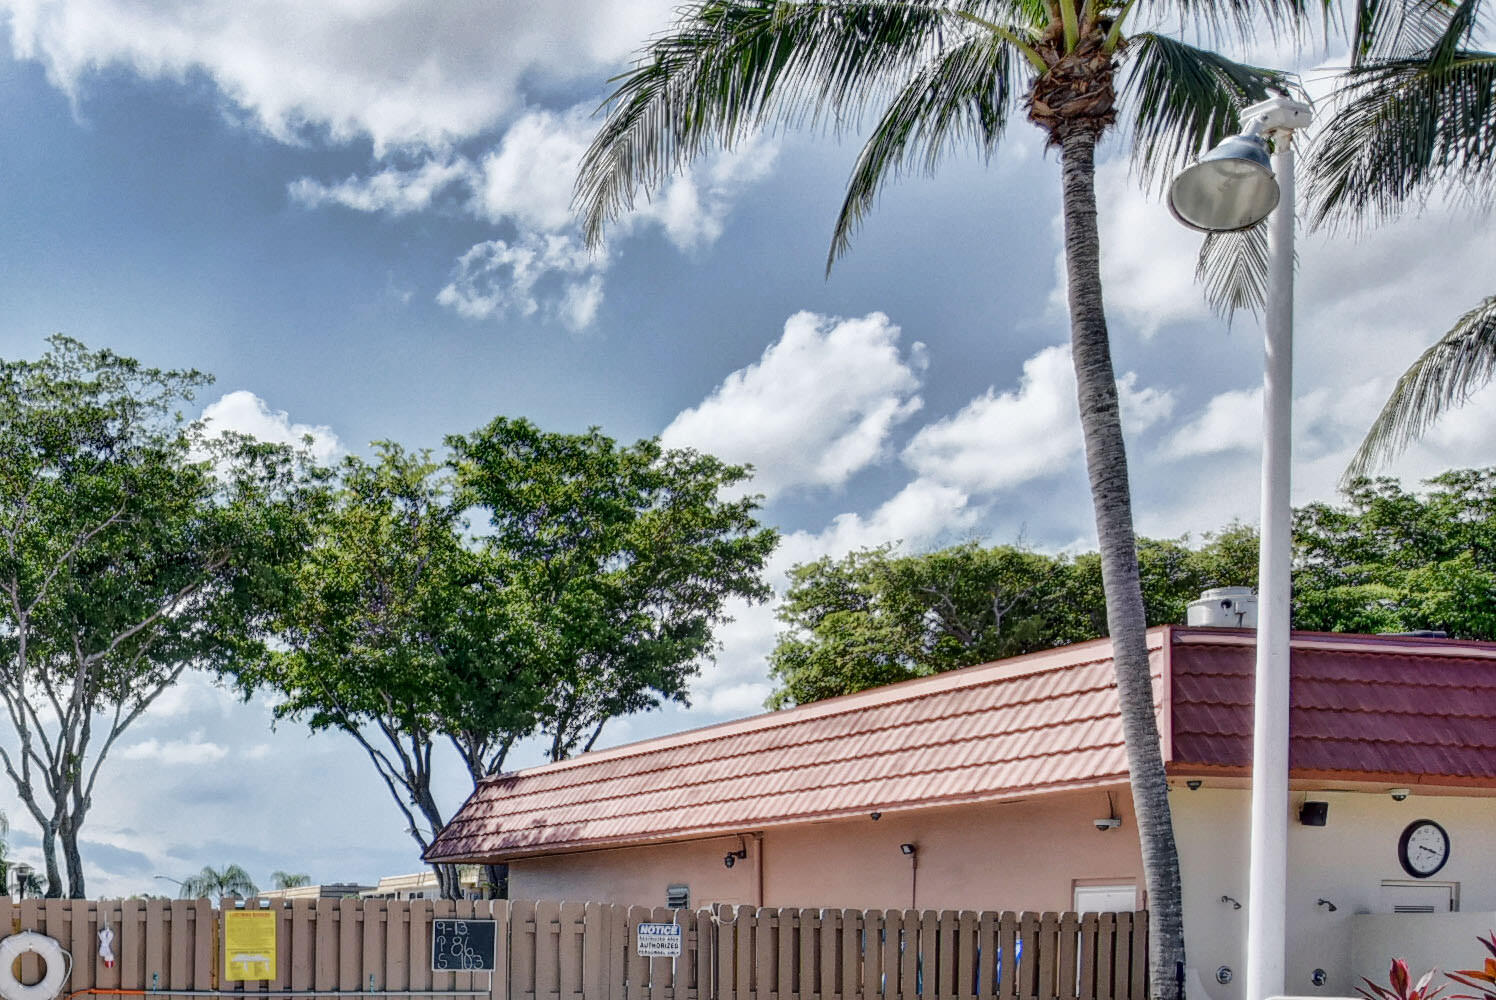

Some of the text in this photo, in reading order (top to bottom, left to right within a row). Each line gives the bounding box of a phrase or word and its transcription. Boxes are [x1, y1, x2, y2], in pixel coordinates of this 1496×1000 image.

[640, 925, 678, 935] NOTICE
[450, 936, 474, 956] 86
[437, 953, 484, 969] S 103
